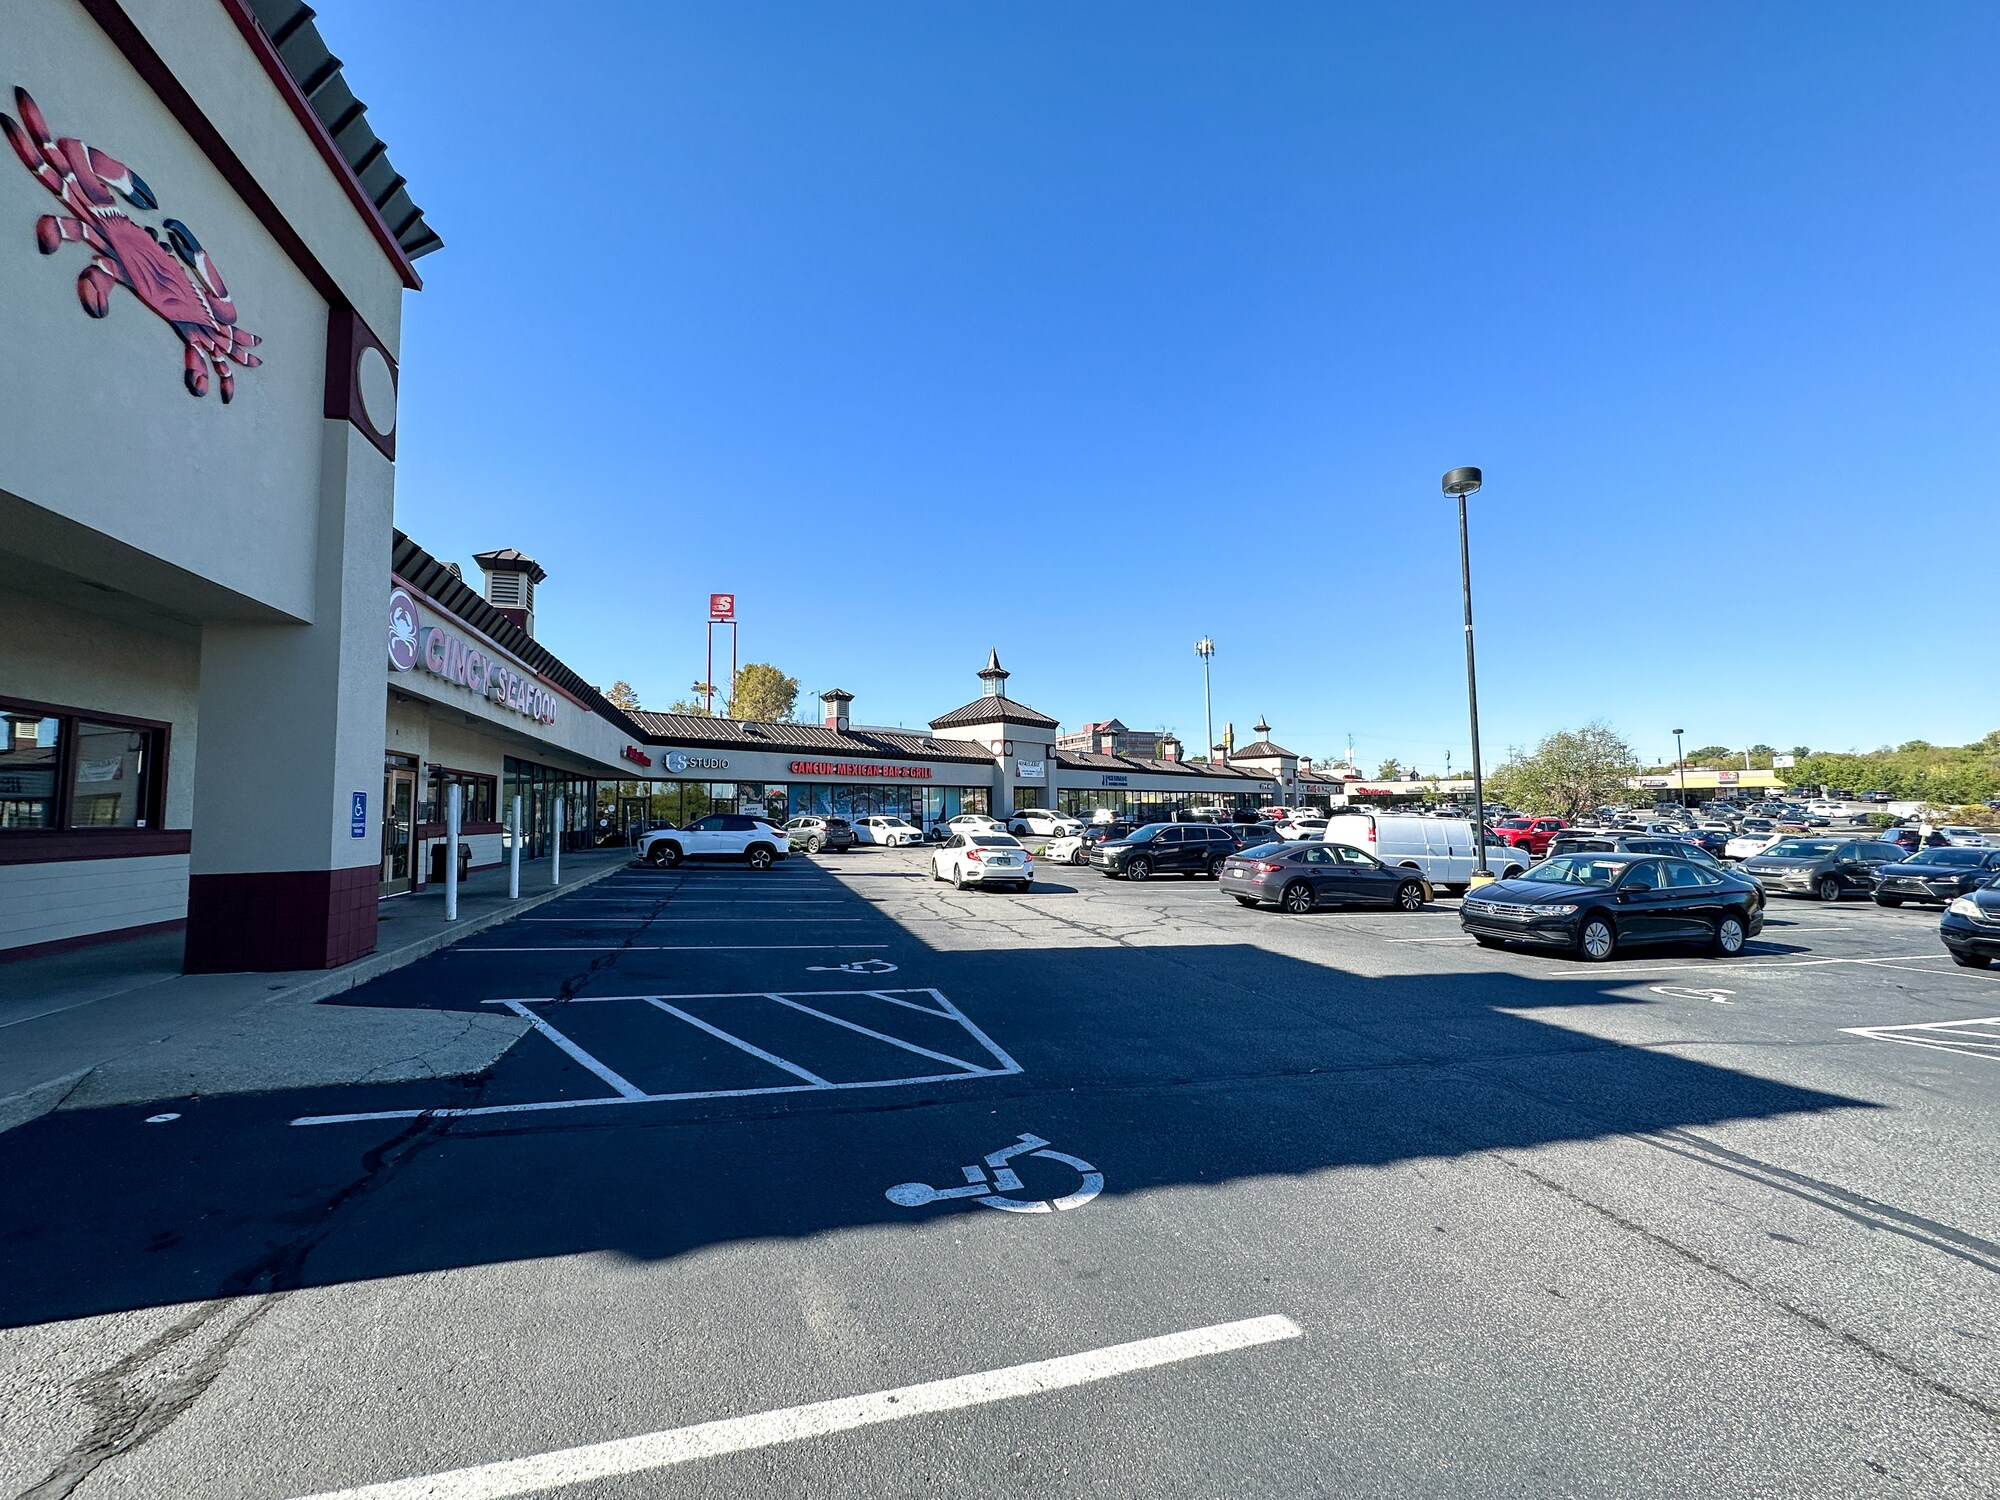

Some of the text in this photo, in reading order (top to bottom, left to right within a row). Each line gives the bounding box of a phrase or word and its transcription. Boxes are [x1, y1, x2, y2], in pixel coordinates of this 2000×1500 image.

[425, 626, 558, 726] CINCY SEAFOOD
[689, 757, 730, 769] STUDIO
[791, 761, 933, 779] CANCUN MEXICAN BAR & GRILL
